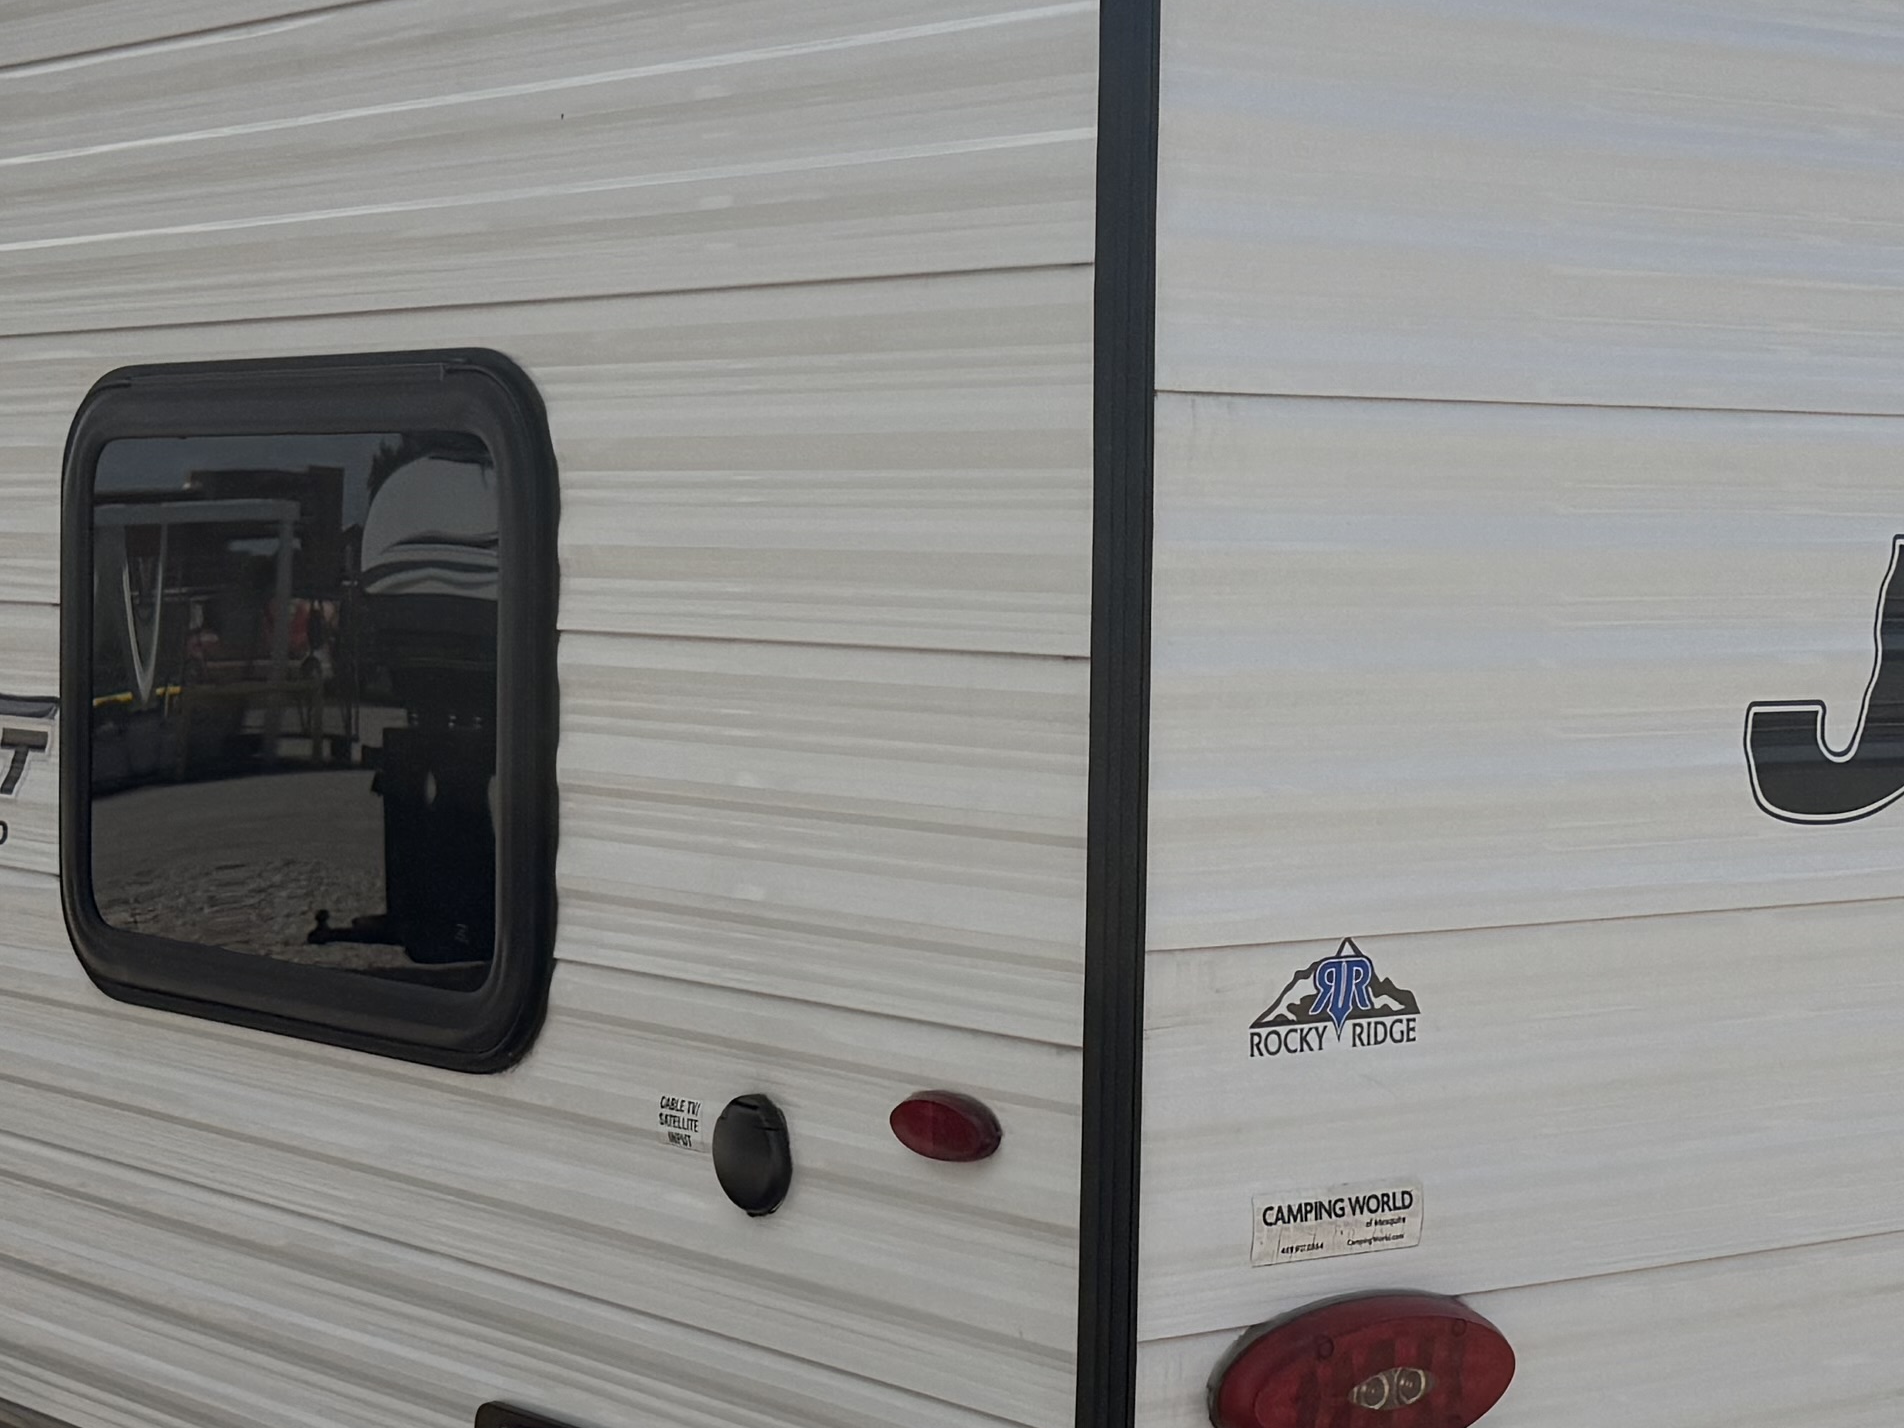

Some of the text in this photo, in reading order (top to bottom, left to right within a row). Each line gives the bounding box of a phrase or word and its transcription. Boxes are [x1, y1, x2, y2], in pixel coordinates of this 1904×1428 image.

[1249, 1017, 1416, 1057] ROCKY RIDGE
[660, 1095, 686, 1113] CABLE
[658, 1112, 698, 1133] SATELLITE
[667, 1131, 692, 1148] INPUT
[1262, 1190, 1413, 1227] CAMPING WORLD
